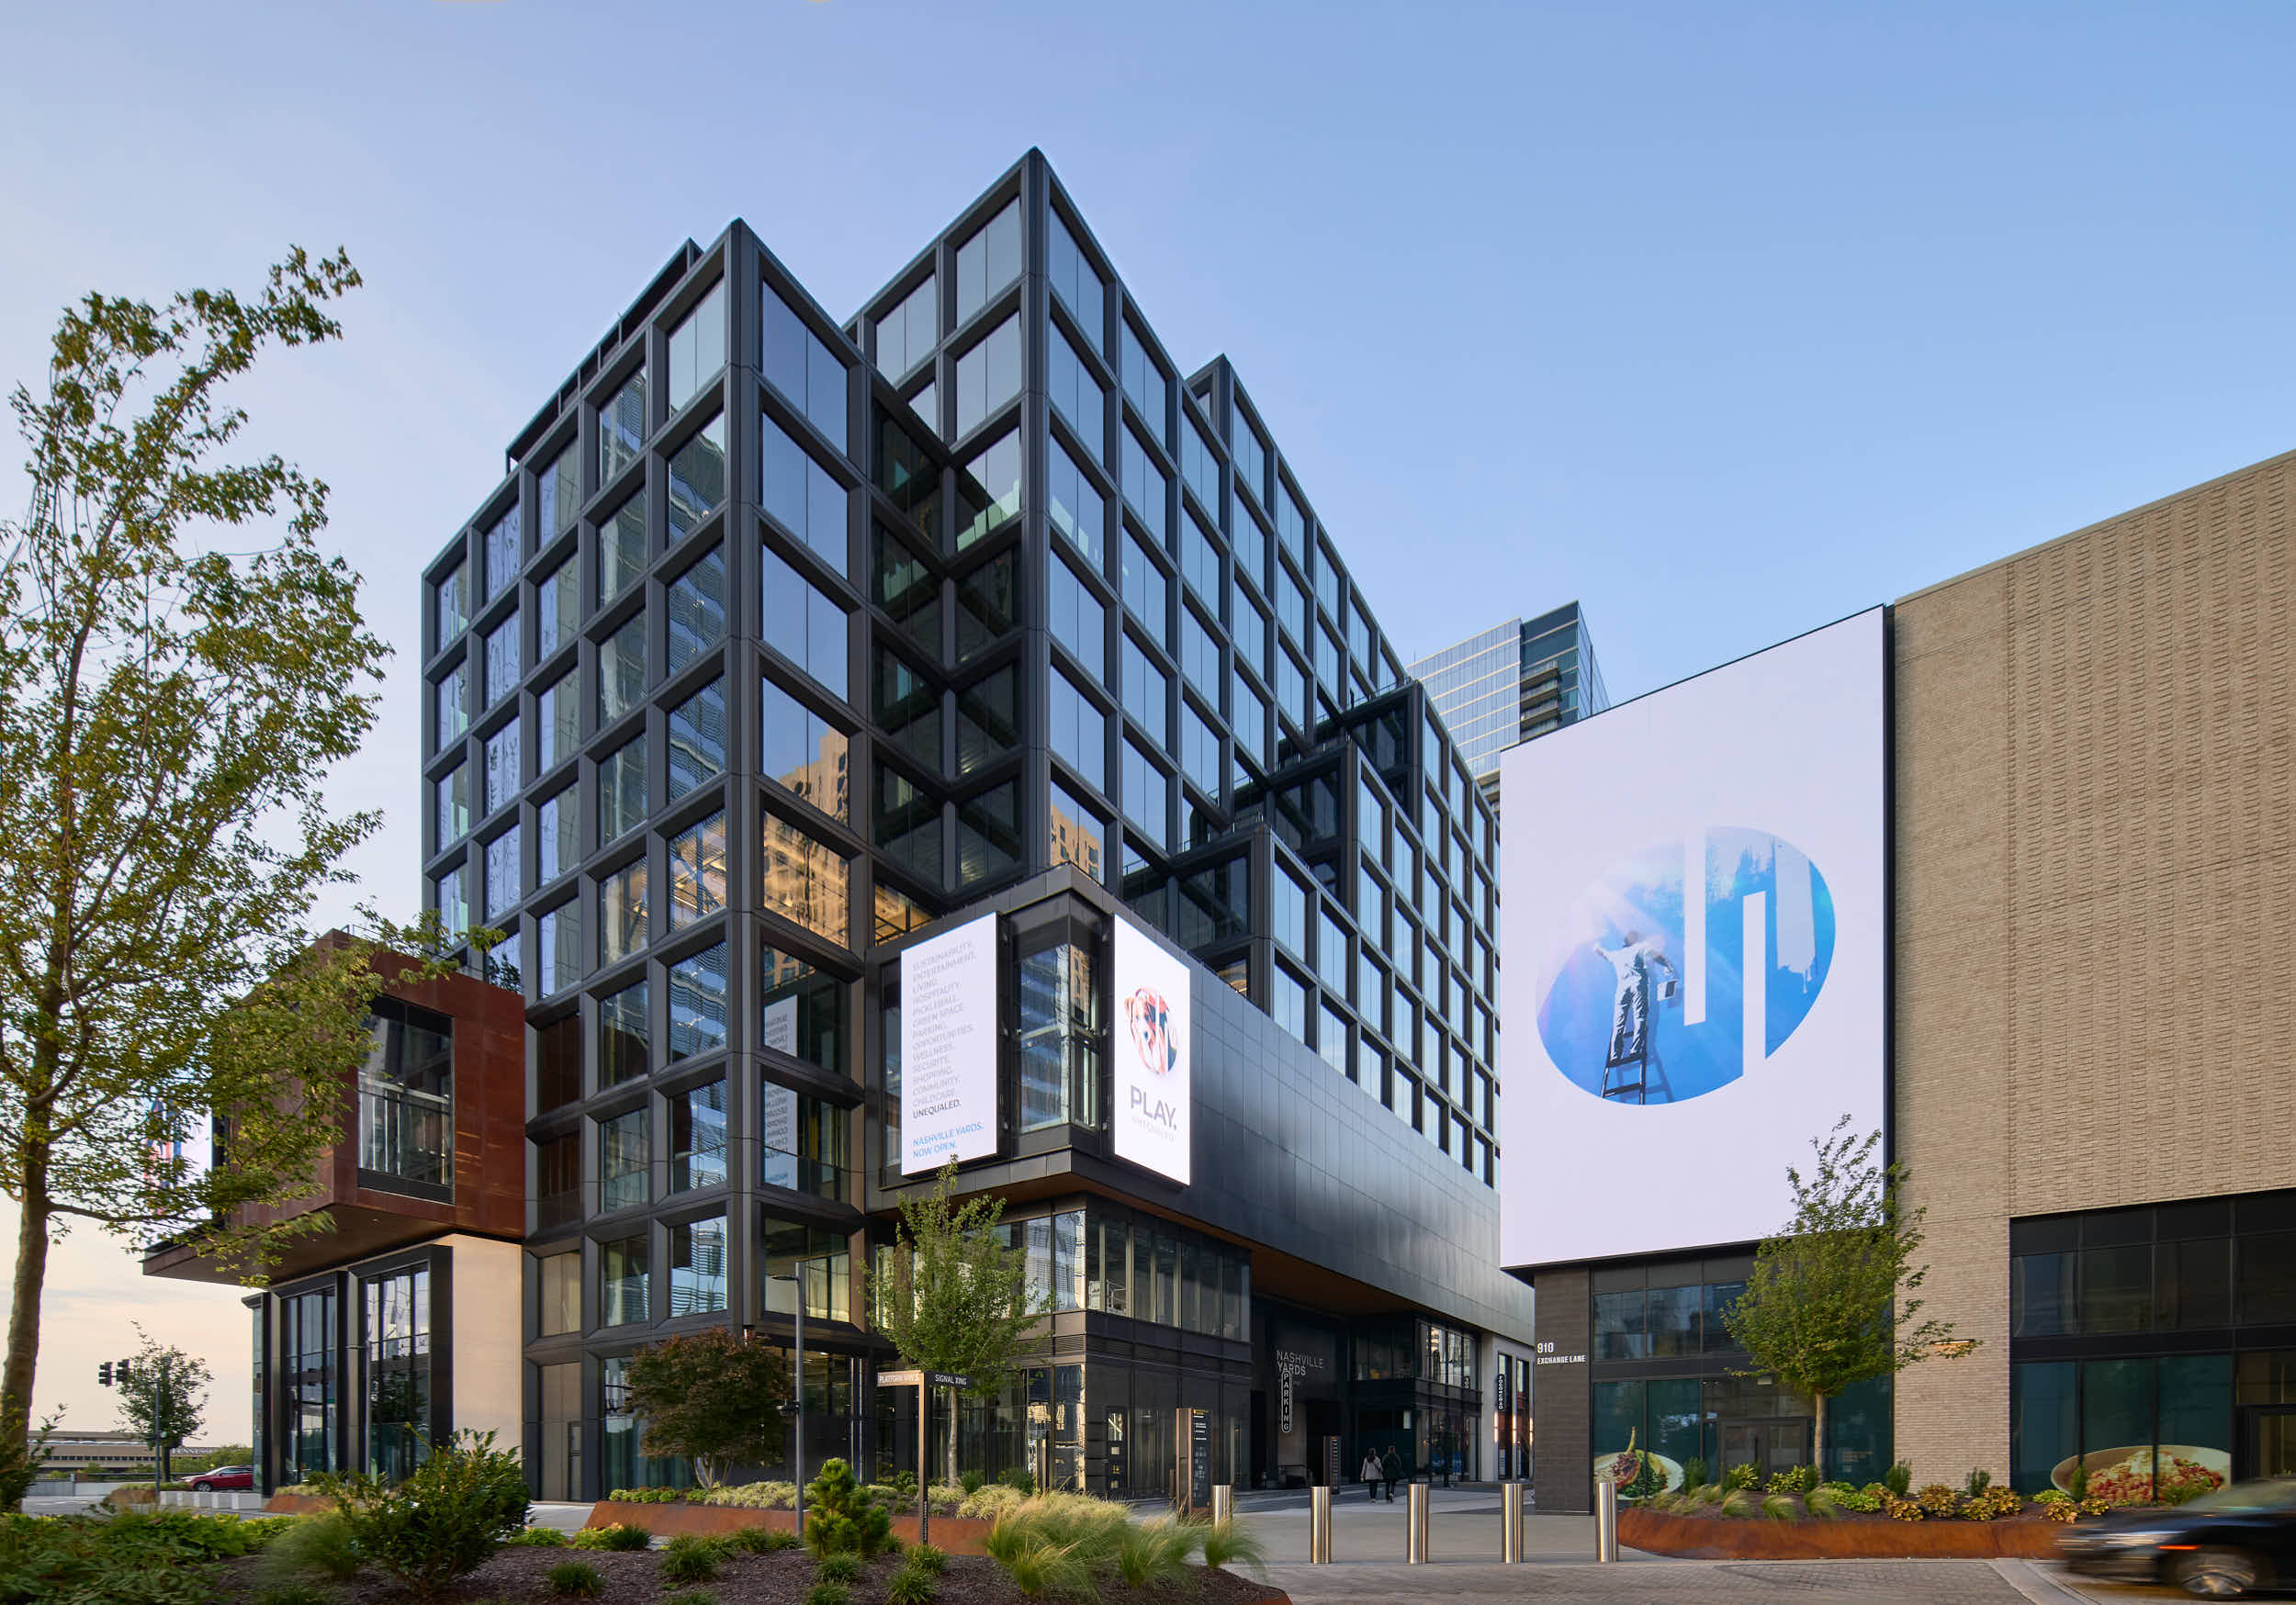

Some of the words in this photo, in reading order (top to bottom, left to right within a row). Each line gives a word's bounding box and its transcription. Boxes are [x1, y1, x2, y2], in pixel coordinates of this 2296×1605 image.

[913, 1099, 961, 1118] UNEQUALED.
[1131, 1084, 1177, 1130] PLAY.
[913, 1130, 954, 1147] NASHVILLE
[955, 1122, 984, 1135] YARDS.
[913, 1148, 931, 1158] NOW
[934, 1141, 956, 1152] OPEN.
[1536, 1341, 1554, 1353] 910
[1277, 1350, 1323, 1368] NASHVILLE
[1536, 1356, 1569, 1365] EXCHANGE
[1570, 1354, 1587, 1363] LANE
[1277, 1361, 1306, 1375] YARDS
[934, 1374, 954, 1384] SIGNAL
[954, 1376, 967, 1386] XING
